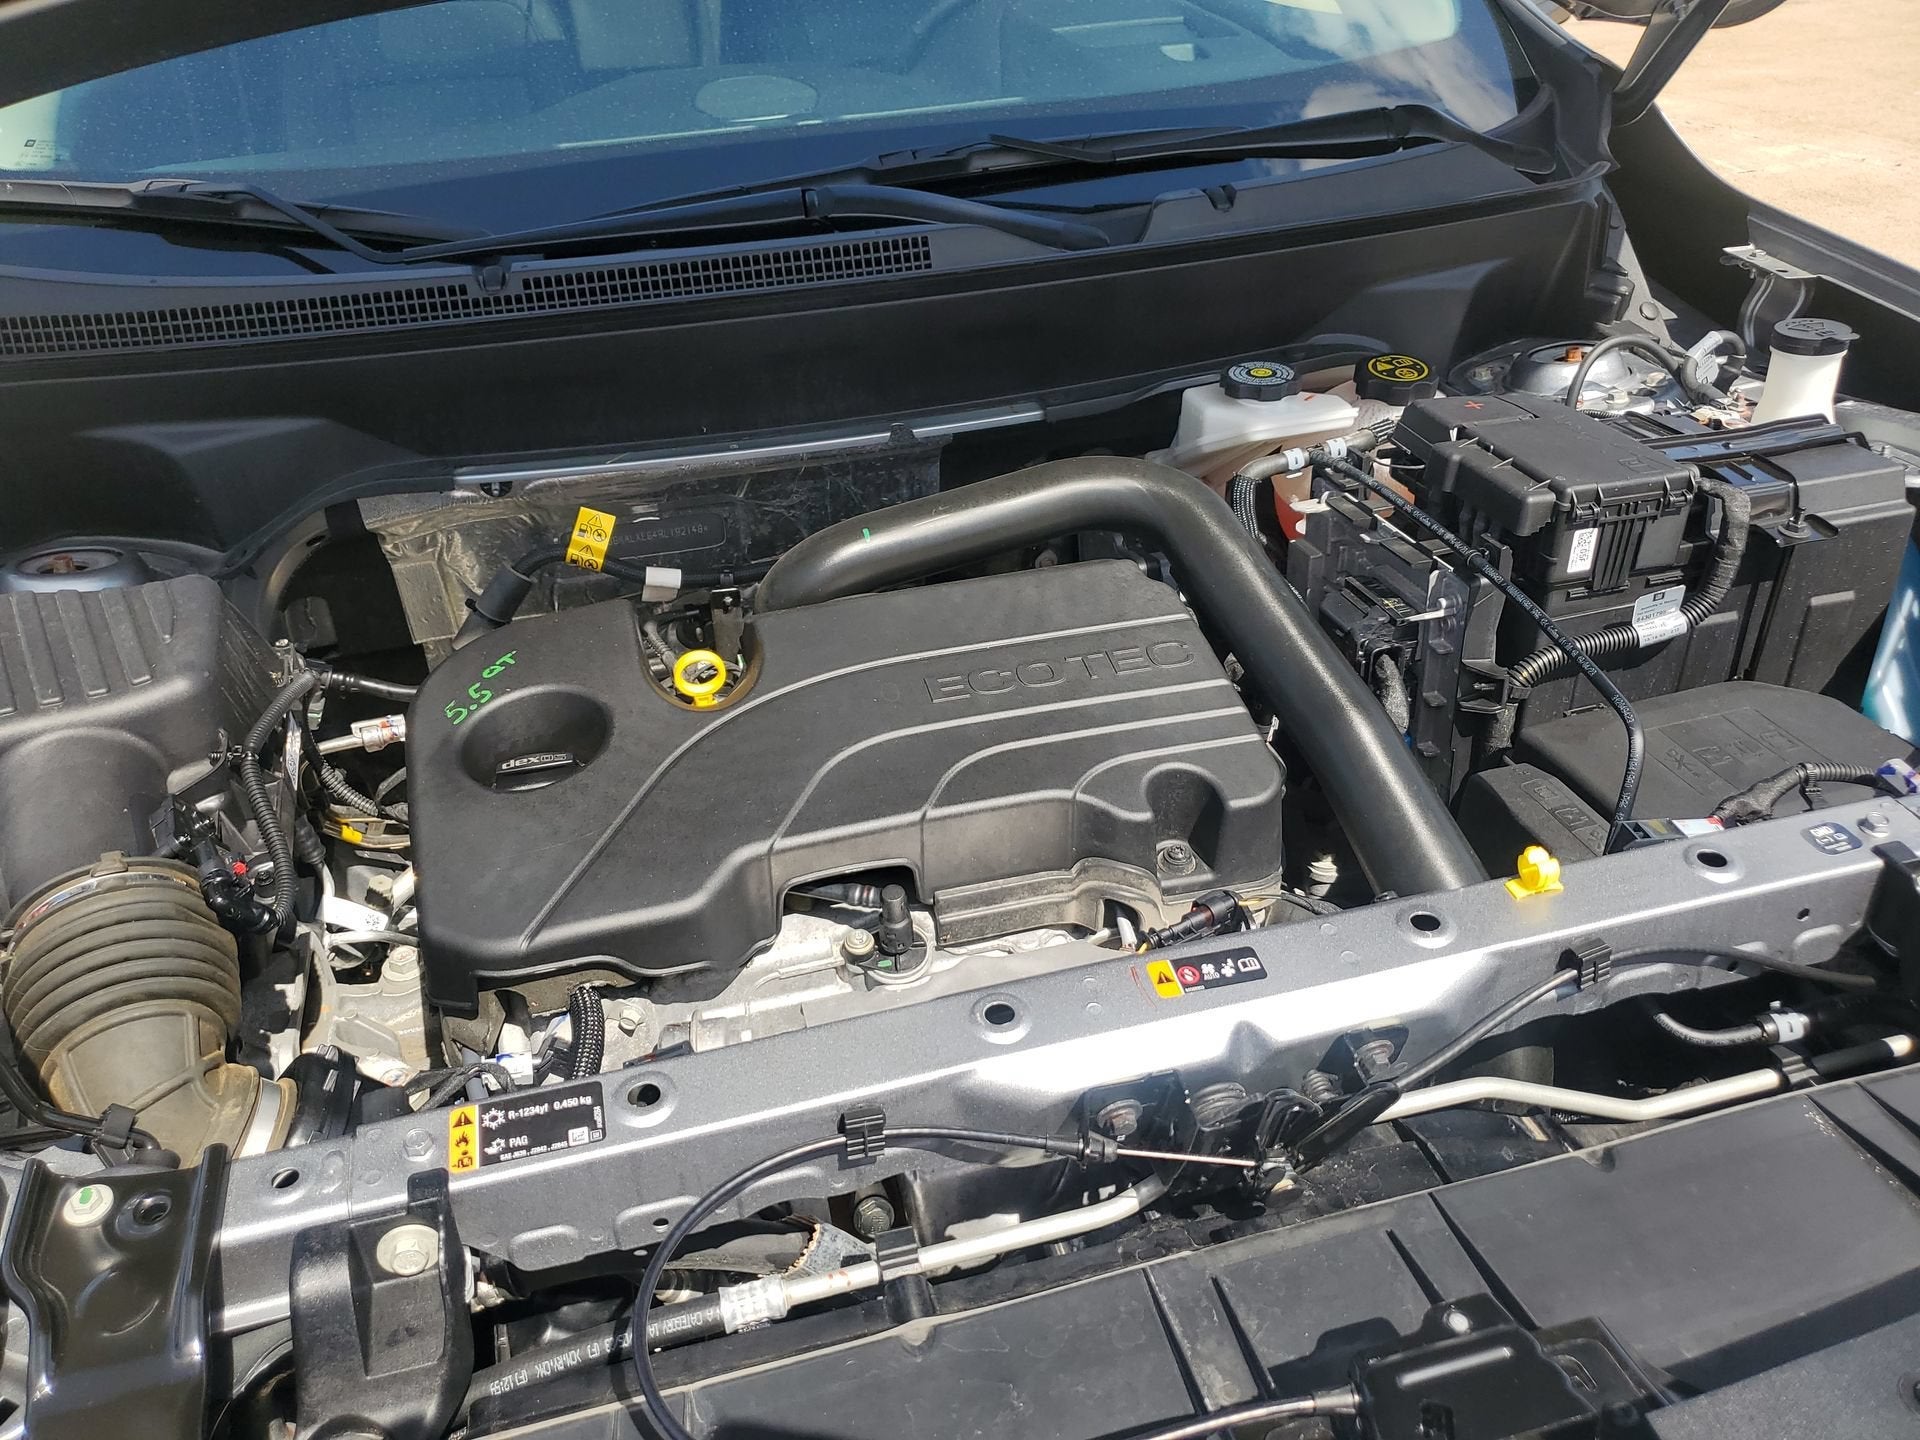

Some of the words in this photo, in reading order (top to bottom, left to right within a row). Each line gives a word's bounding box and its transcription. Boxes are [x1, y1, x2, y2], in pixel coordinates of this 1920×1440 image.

[923, 641, 1195, 703] ECOTEC
[444, 682, 493, 725] 5.5
[1203, 971, 1220, 981] AUTO
[508, 1103, 549, 1120] R-1234yf
[553, 1097, 579, 1111] 0.450
[580, 1095, 592, 1105] kg
[509, 1135, 528, 1148] PAG
